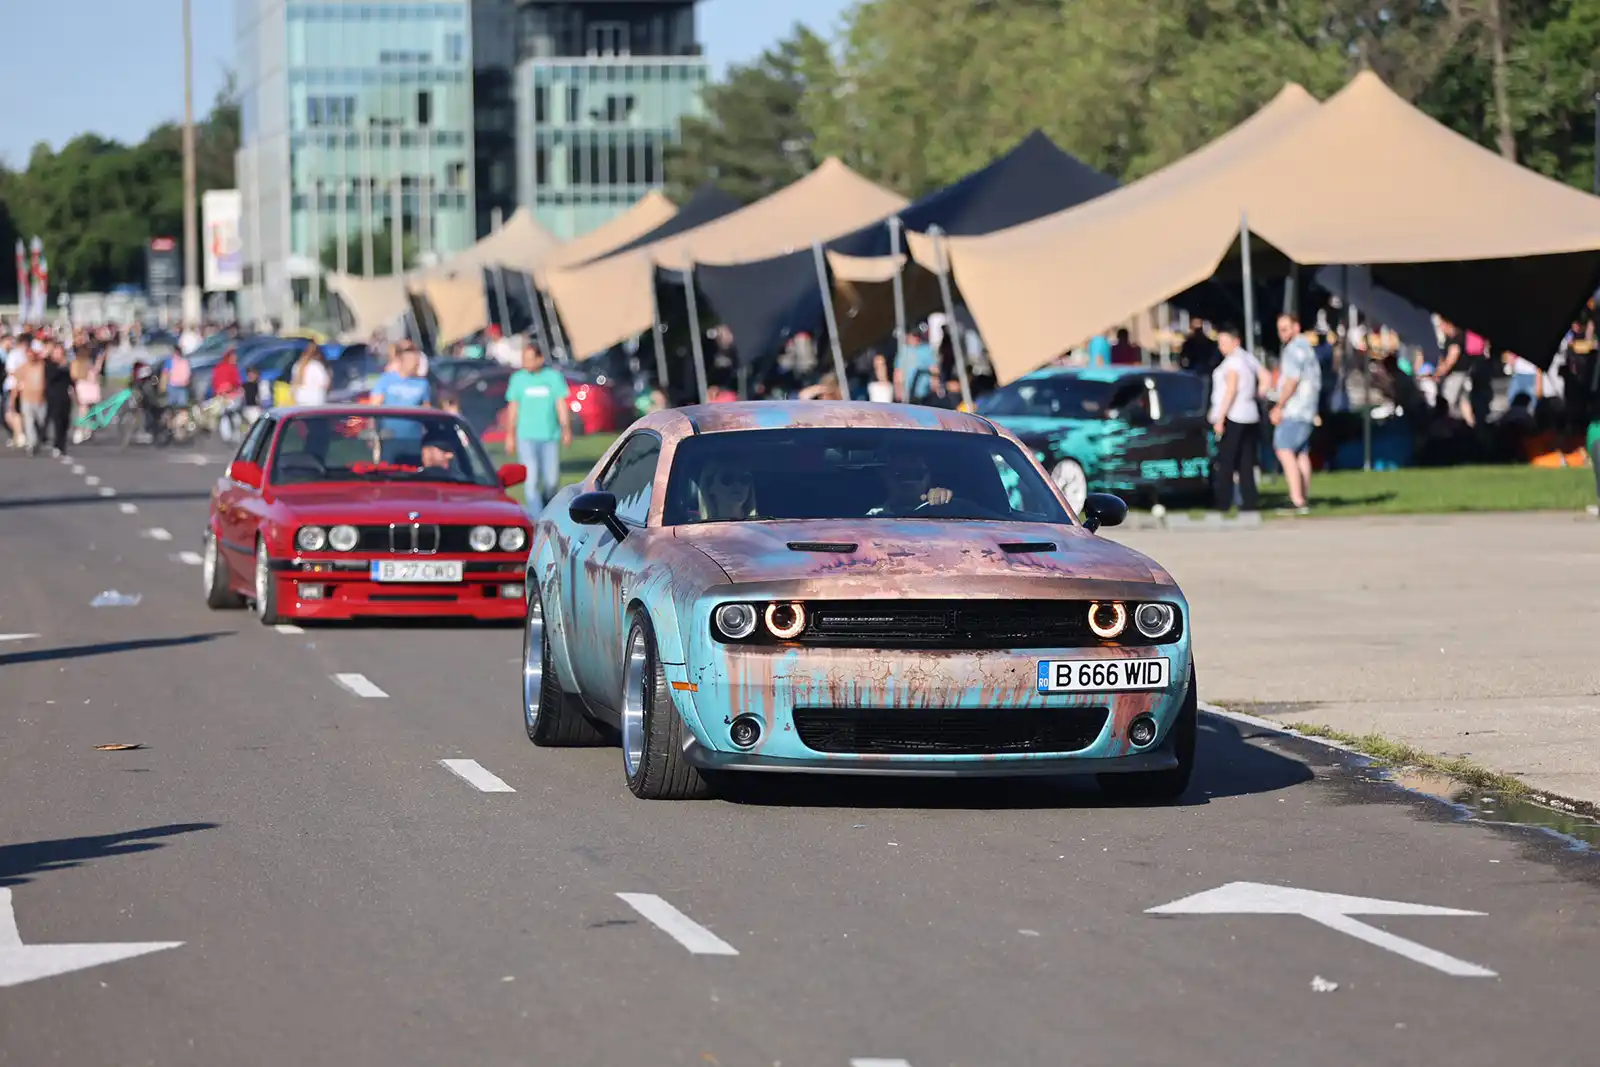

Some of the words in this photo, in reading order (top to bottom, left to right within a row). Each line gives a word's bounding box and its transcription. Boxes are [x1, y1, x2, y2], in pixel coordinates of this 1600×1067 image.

[383, 562, 395, 578] B
[1055, 664, 1072, 687] B
[1078, 663, 1119, 686] 666
[1124, 661, 1162, 685] WID
[1038, 678, 1049, 688] RO
